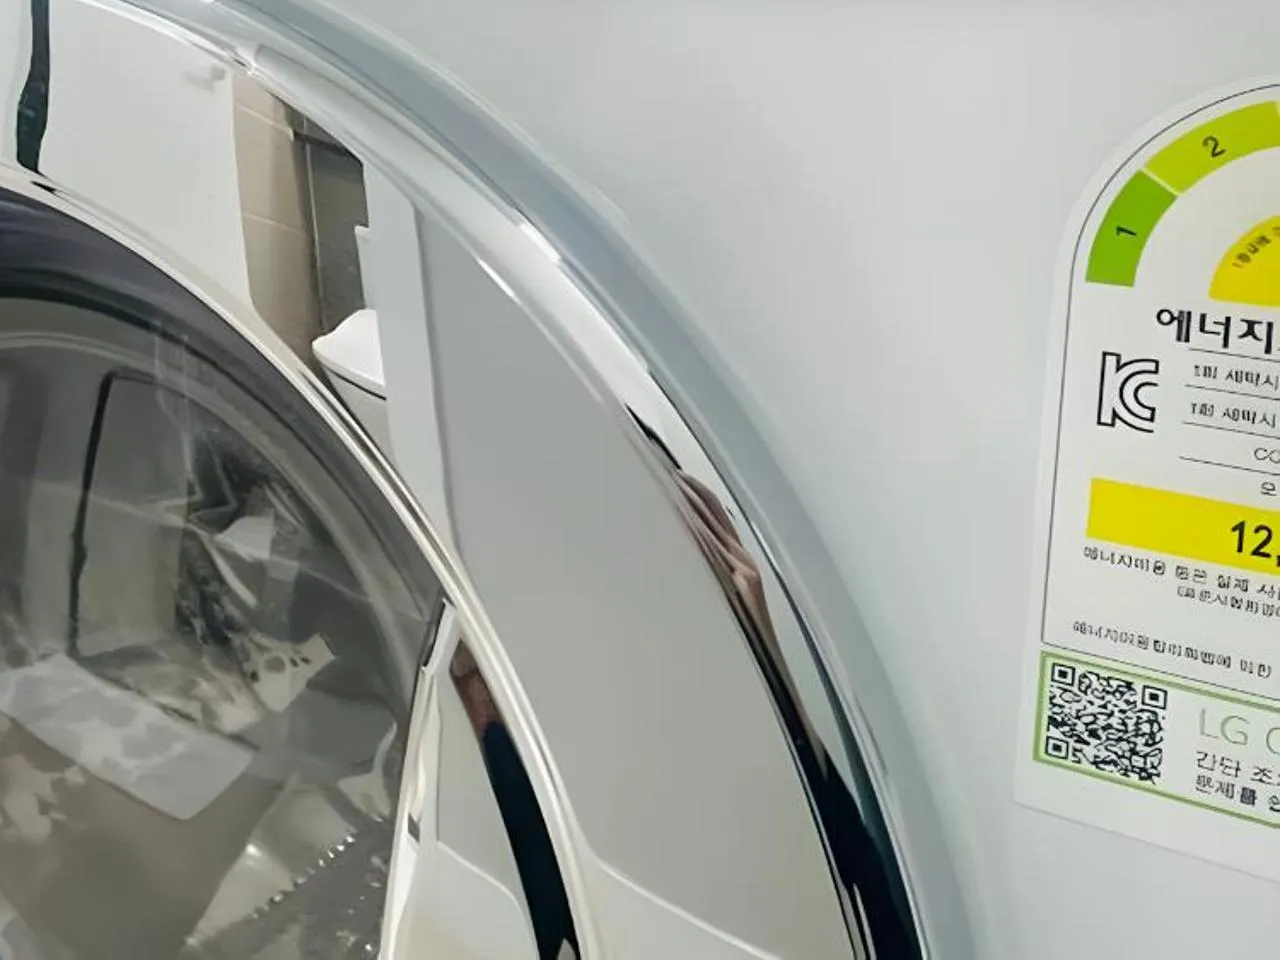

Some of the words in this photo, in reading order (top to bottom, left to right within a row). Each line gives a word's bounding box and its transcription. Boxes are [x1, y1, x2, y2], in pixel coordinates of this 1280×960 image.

[1202, 135, 1227, 158] 2
[1116, 225, 1138, 239] 1
[1156, 308, 1280, 355] 에너지
[1231, 520, 1280, 568] 12,
[1200, 707, 1250, 746] LG
